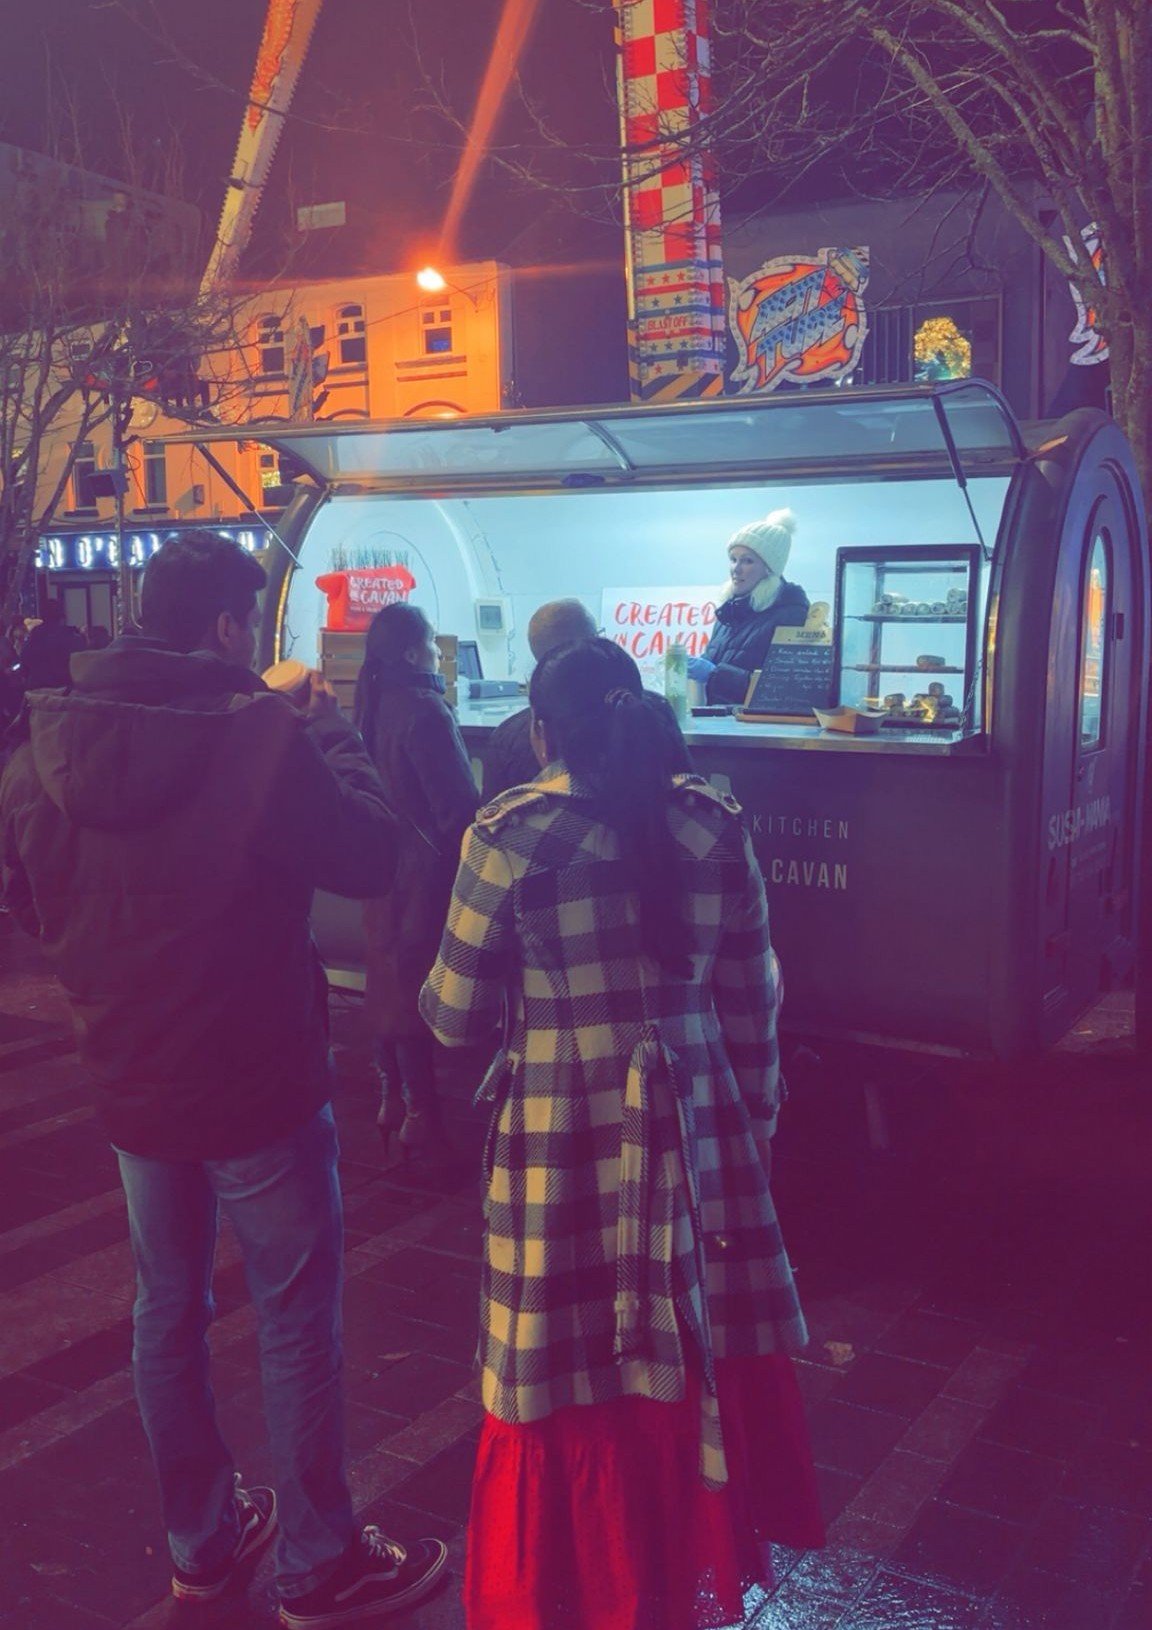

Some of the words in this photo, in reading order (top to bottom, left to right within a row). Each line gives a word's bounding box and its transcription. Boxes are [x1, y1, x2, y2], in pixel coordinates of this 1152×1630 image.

[648, 317, 673, 330] BLAST
[674, 315, 689, 327] OFF
[361, 590, 407, 606] CAVAN
[615, 601, 716, 627] CREATED
[753, 814, 848, 839] KITCHEN
[771, 858, 847, 890] CAVAN
